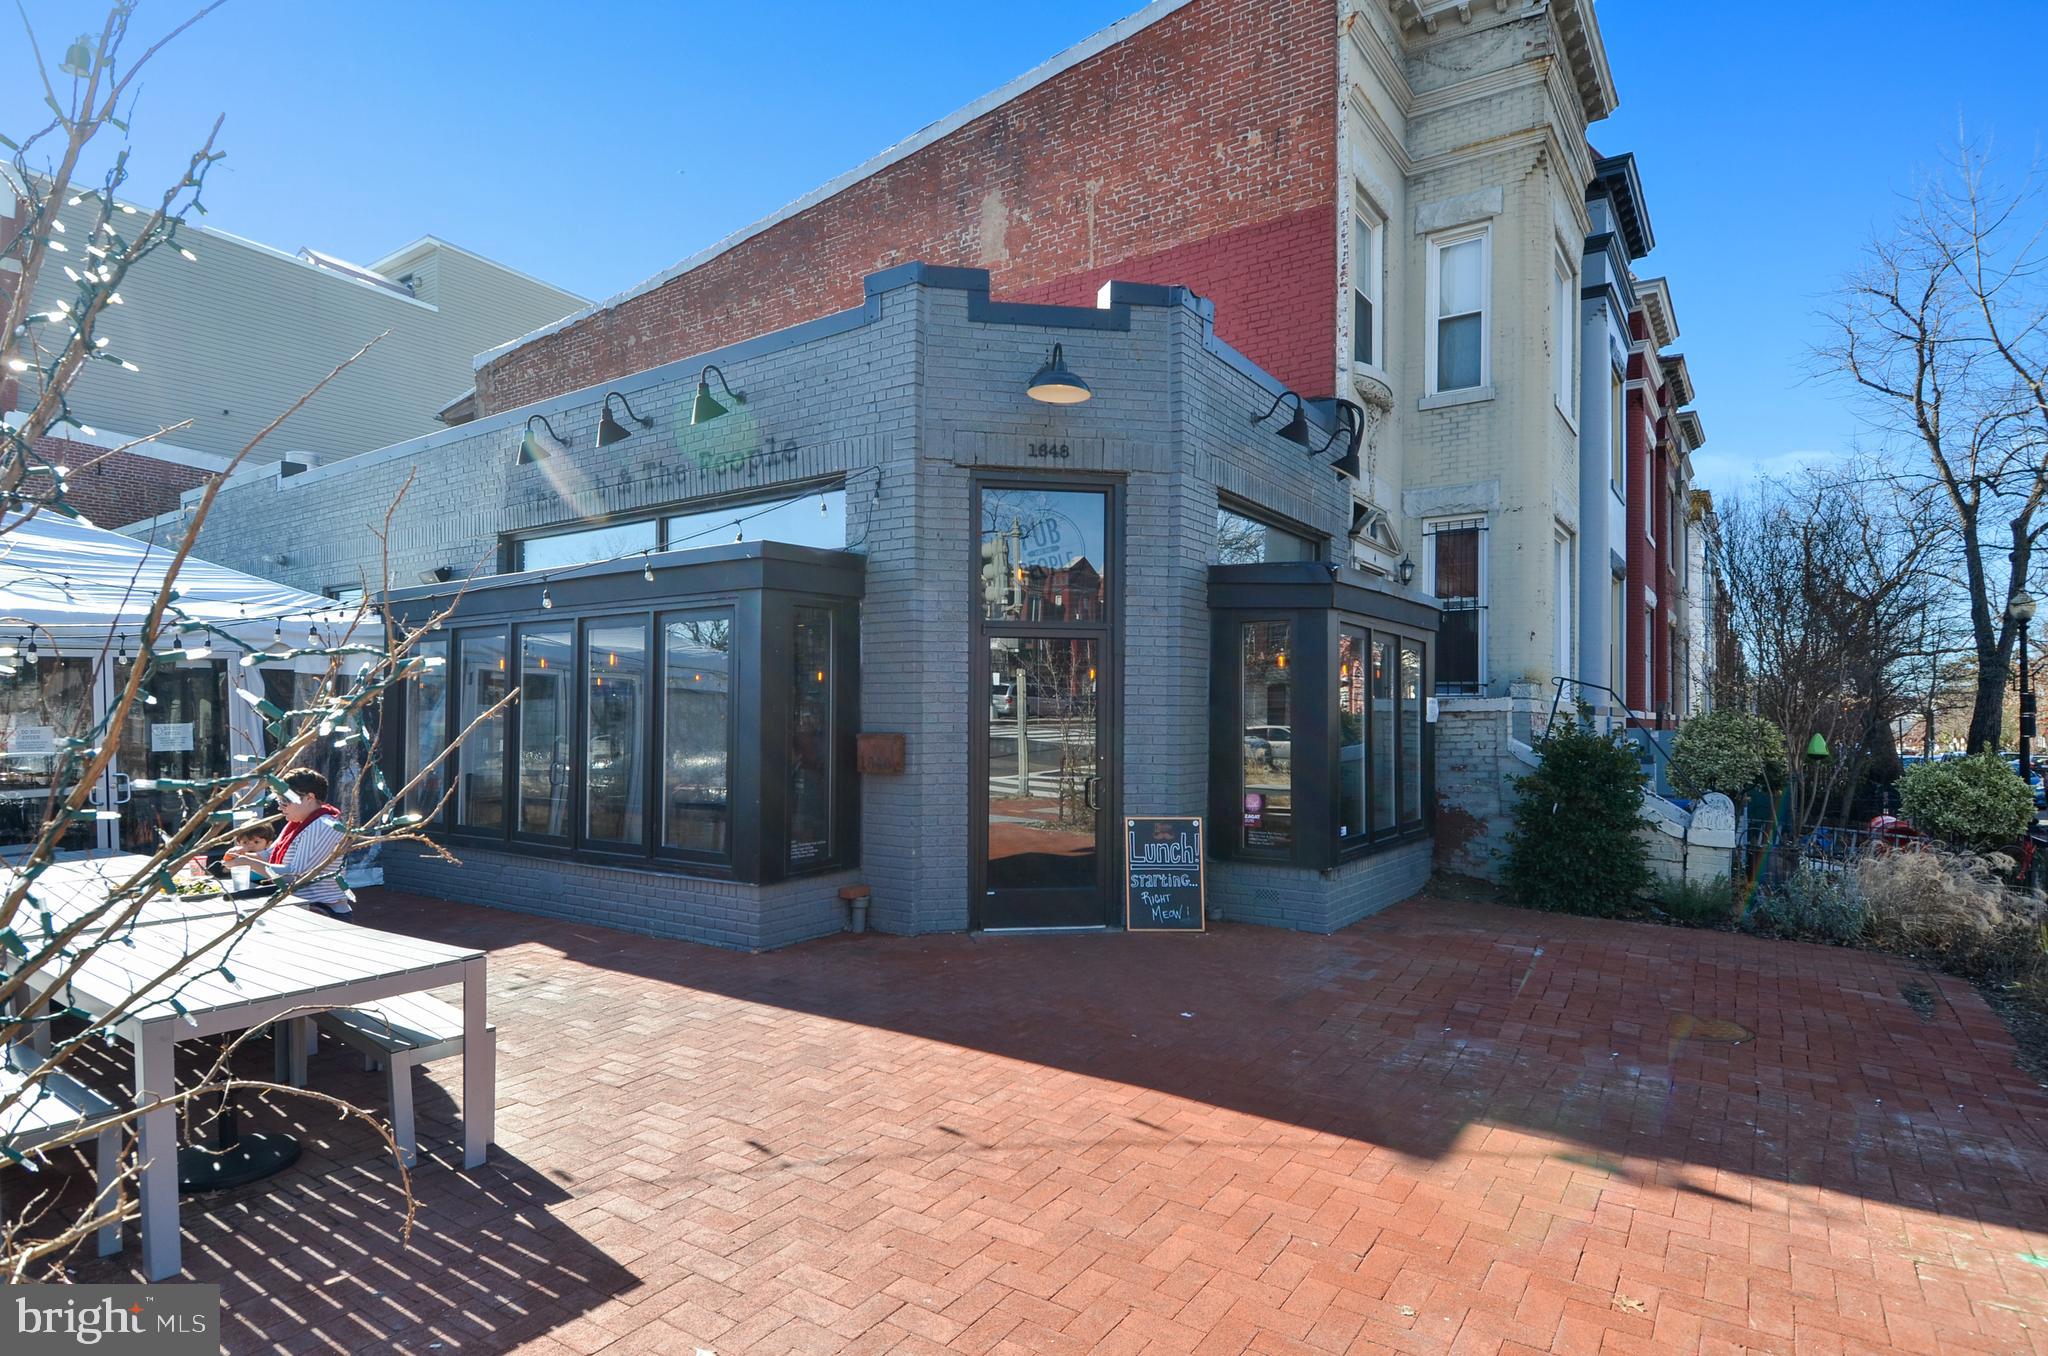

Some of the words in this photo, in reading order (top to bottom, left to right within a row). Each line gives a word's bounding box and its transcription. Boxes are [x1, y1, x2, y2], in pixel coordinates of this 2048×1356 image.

[697, 436, 798, 480] People
[1129, 831, 1200, 864] Lunch!
[1141, 891, 1171, 906] RIGHT
